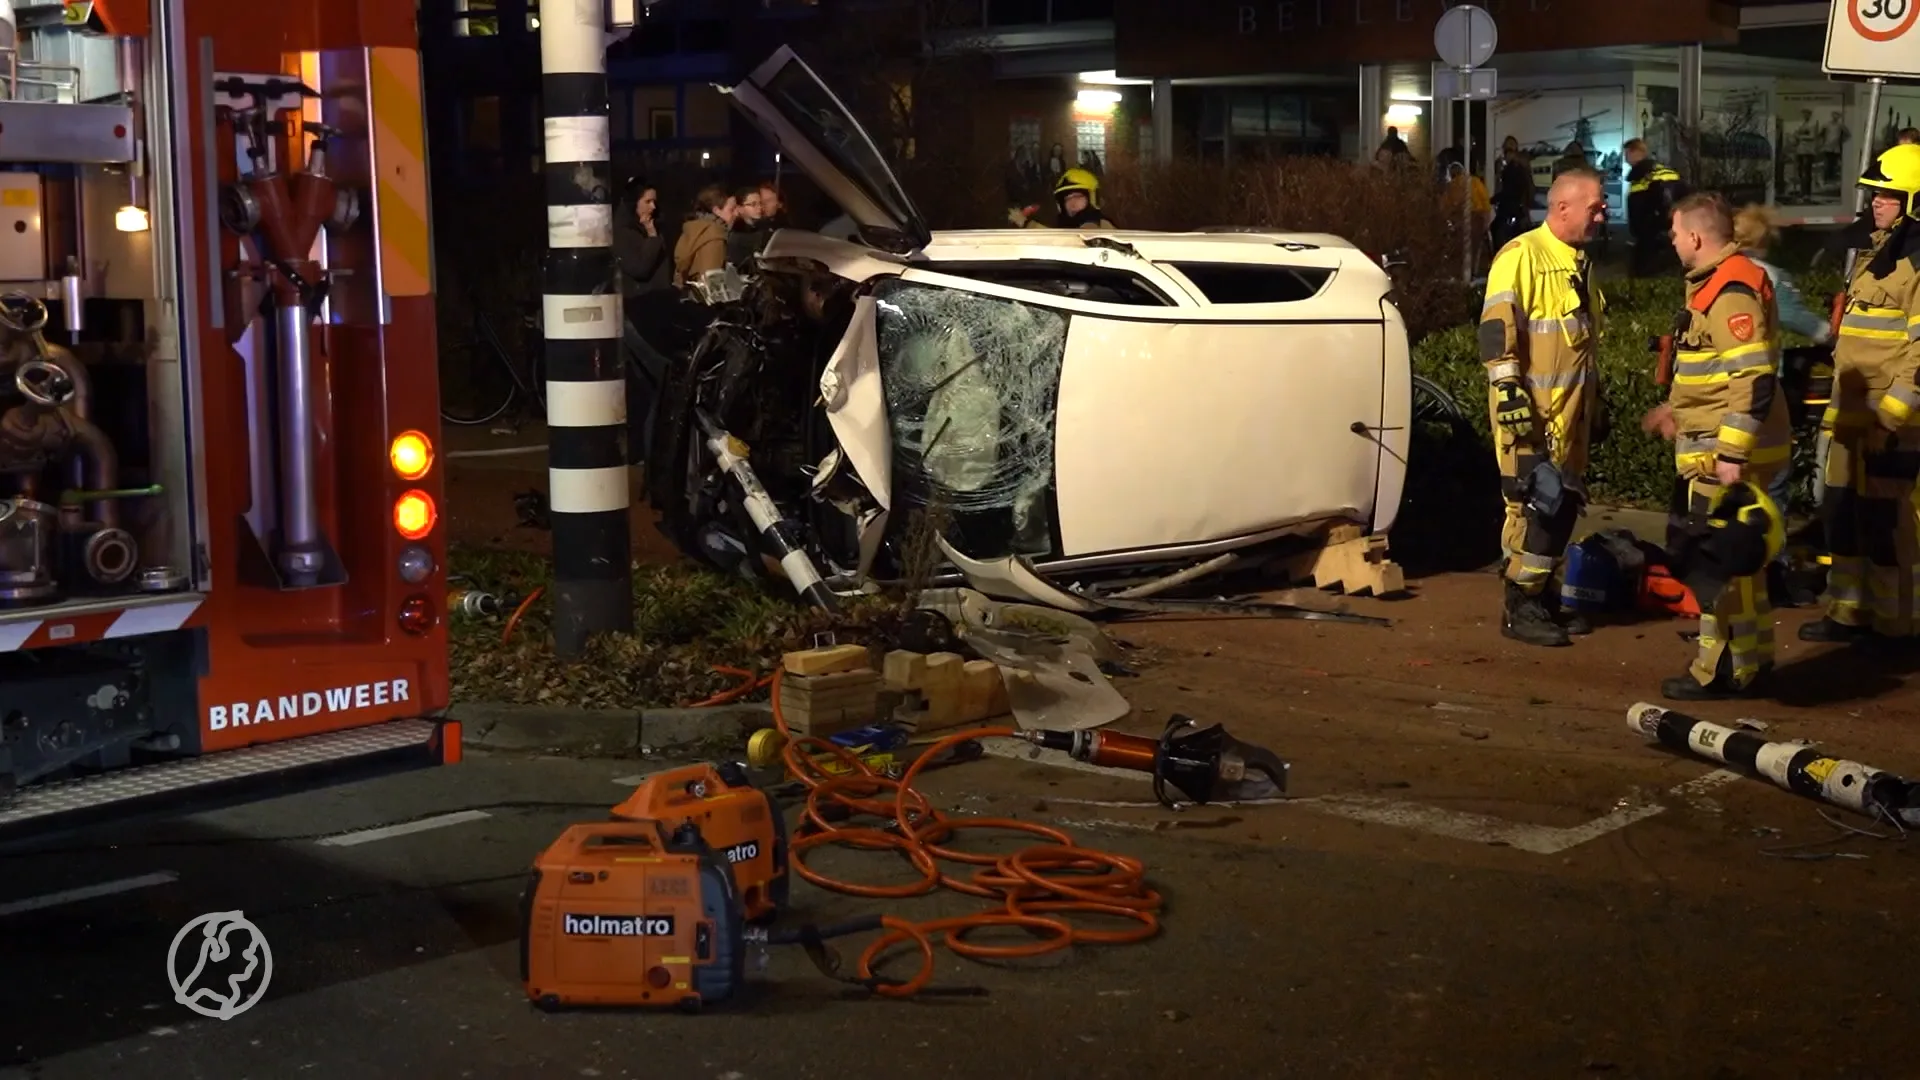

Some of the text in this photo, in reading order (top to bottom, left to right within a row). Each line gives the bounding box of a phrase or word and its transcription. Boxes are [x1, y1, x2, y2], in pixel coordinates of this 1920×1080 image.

[1238, 0, 1551, 34] BELLE
[1862, 0, 1906, 19] 30
[209, 678, 410, 731] BRANDWEER
[727, 843, 757, 863] atro
[565, 914, 670, 936] holmatro
